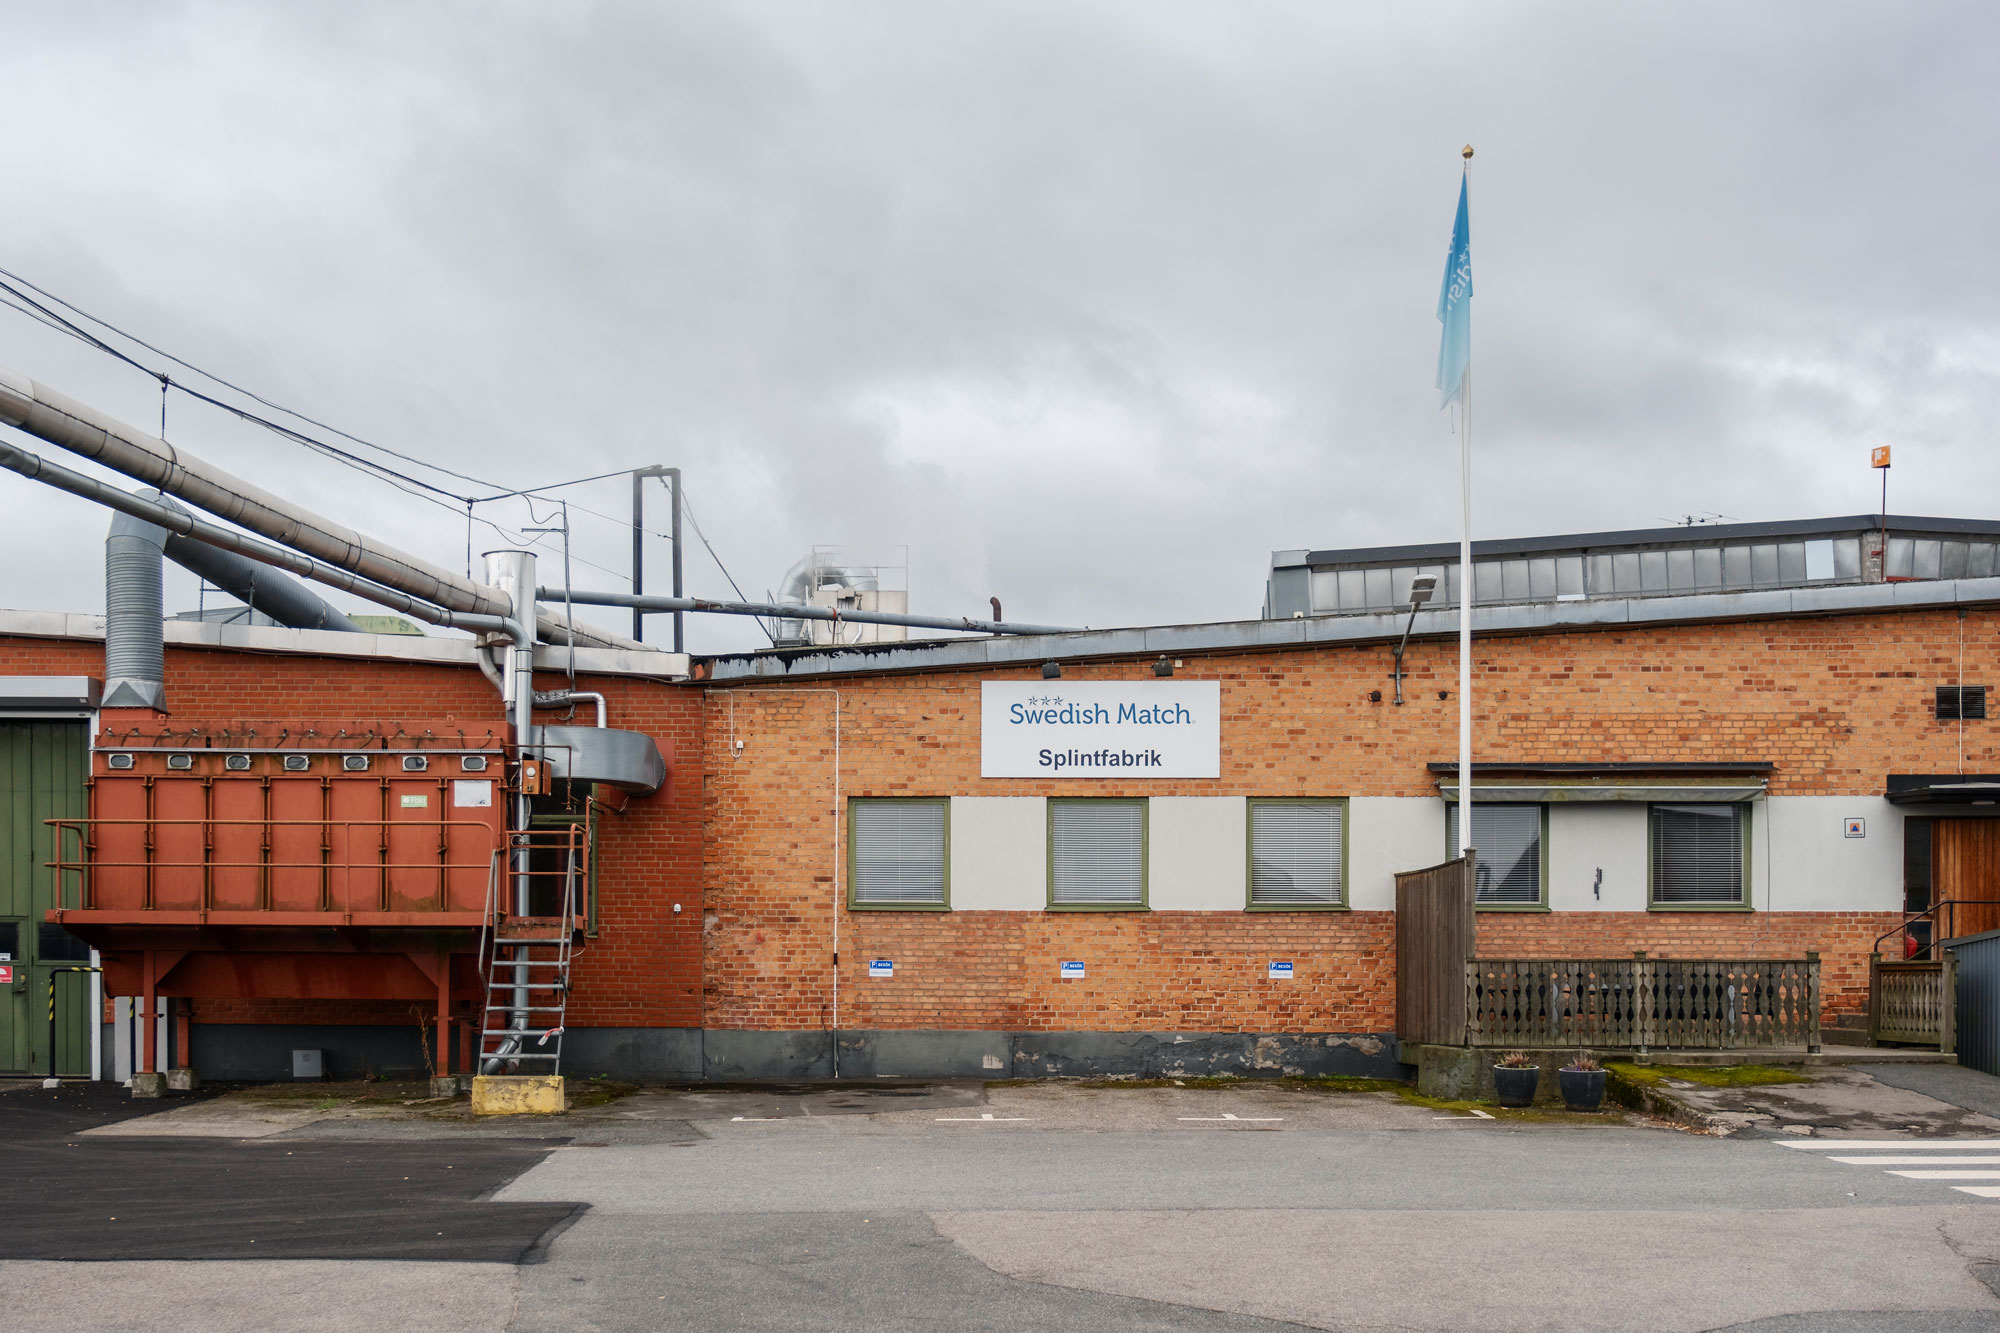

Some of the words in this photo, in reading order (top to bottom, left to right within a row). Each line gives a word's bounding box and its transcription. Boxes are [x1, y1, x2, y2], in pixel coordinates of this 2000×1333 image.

[1009, 702, 1110, 725] Swedish
[1117, 702, 1191, 725] Match
[1038, 749, 1163, 771] Splintfabrik
